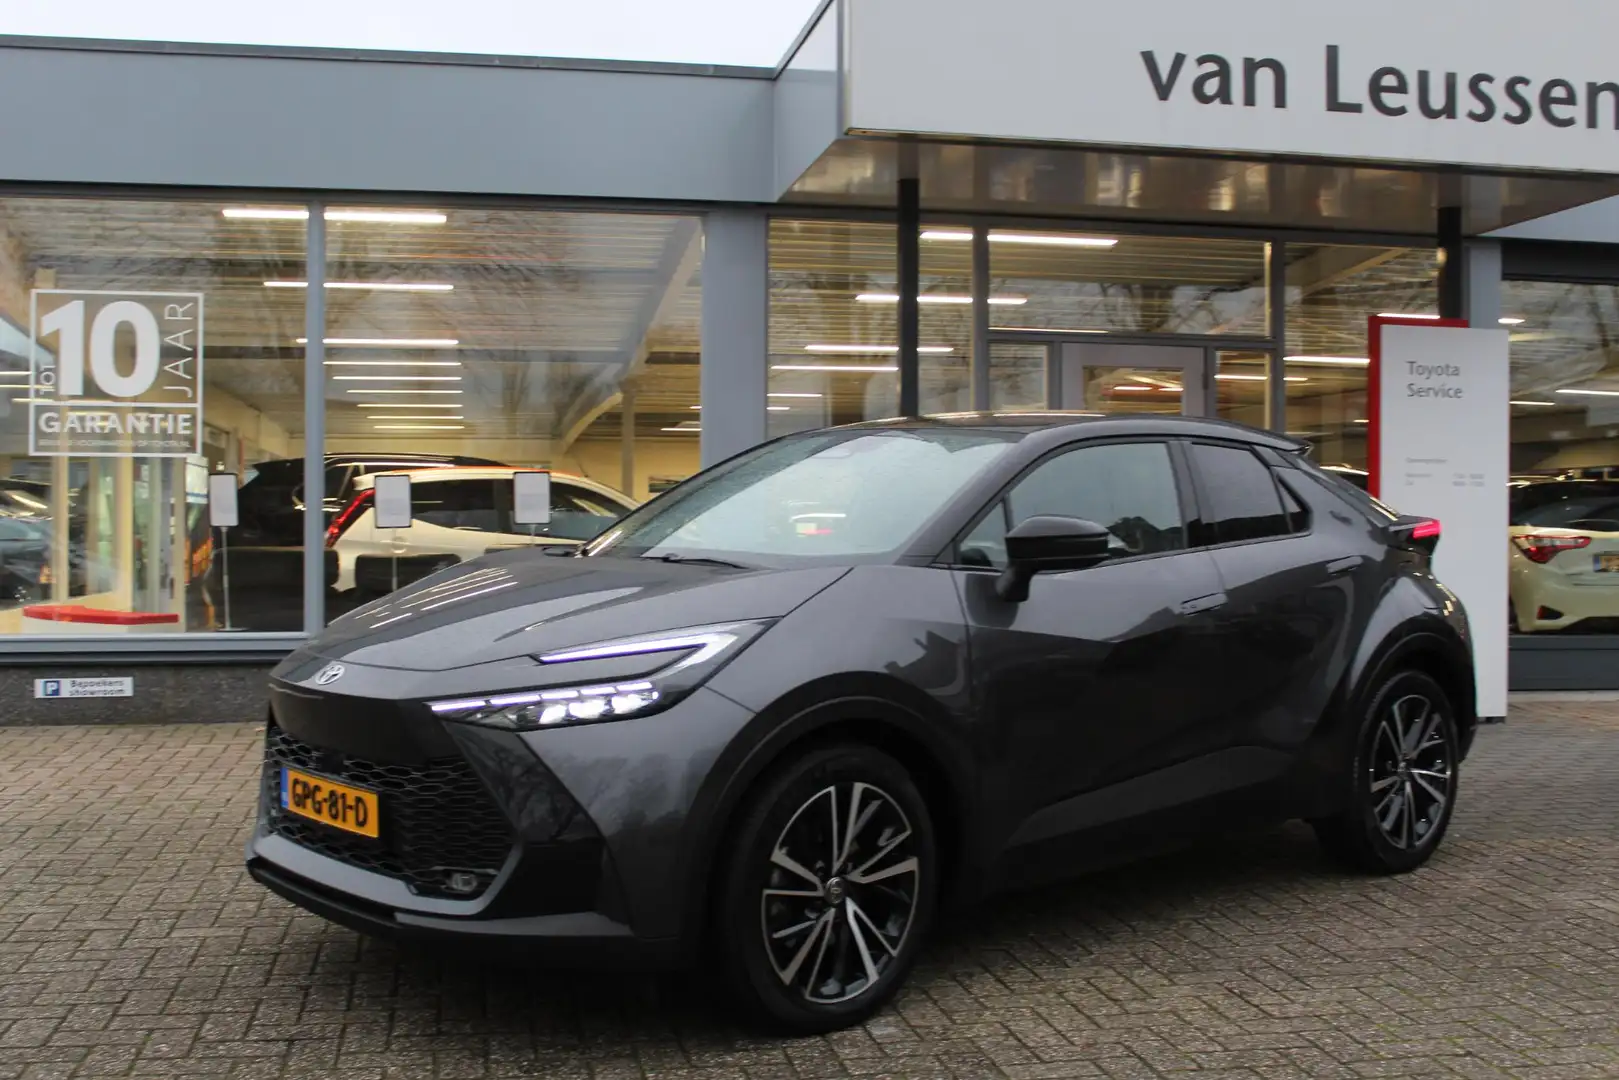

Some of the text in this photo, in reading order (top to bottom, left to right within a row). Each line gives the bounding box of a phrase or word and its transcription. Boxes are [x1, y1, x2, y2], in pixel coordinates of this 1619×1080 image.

[1140, 44, 1619, 131] van Leussen
[40, 300, 160, 397] 10
[163, 302, 194, 398] JAAR
[1406, 361, 1461, 380] Toyota
[1407, 383, 1463, 399] Service
[38, 411, 193, 435] GARANTIE
[292, 778, 368, 827] GPG-81-D
